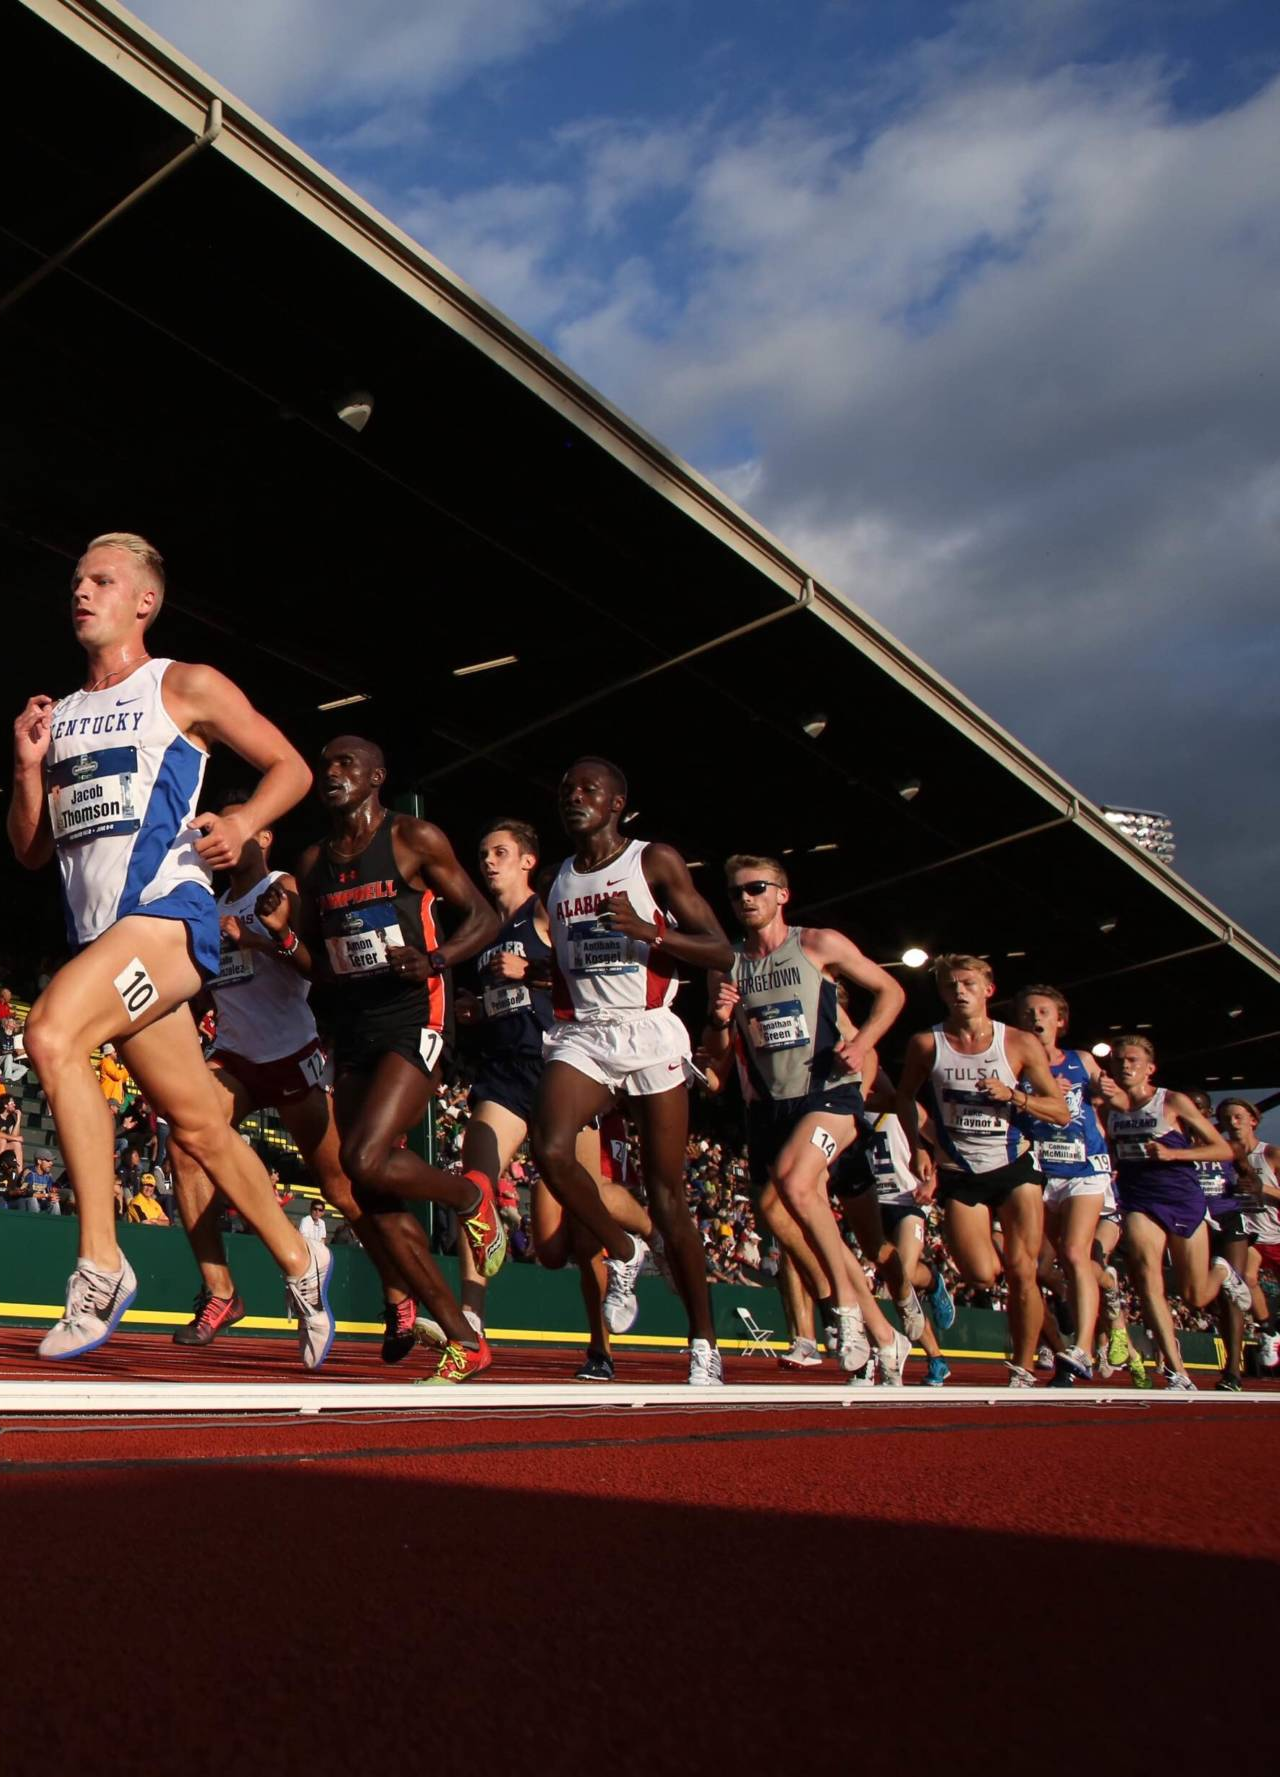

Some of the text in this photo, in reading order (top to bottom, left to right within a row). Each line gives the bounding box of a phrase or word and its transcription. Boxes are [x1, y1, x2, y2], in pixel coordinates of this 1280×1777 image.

[70, 784, 103, 805] Jacob
[61, 800, 120, 829] Thomson
[557, 890, 629, 920] ALABA
[346, 939, 373, 953] Amon
[348, 952, 378, 967] Terer
[122, 971, 154, 1012] 10
[426, 1033, 437, 1062] 7
[944, 1068, 1000, 1081] TULSA
[821, 1133, 836, 1157] 14
[1094, 1155, 1109, 1170] 19
